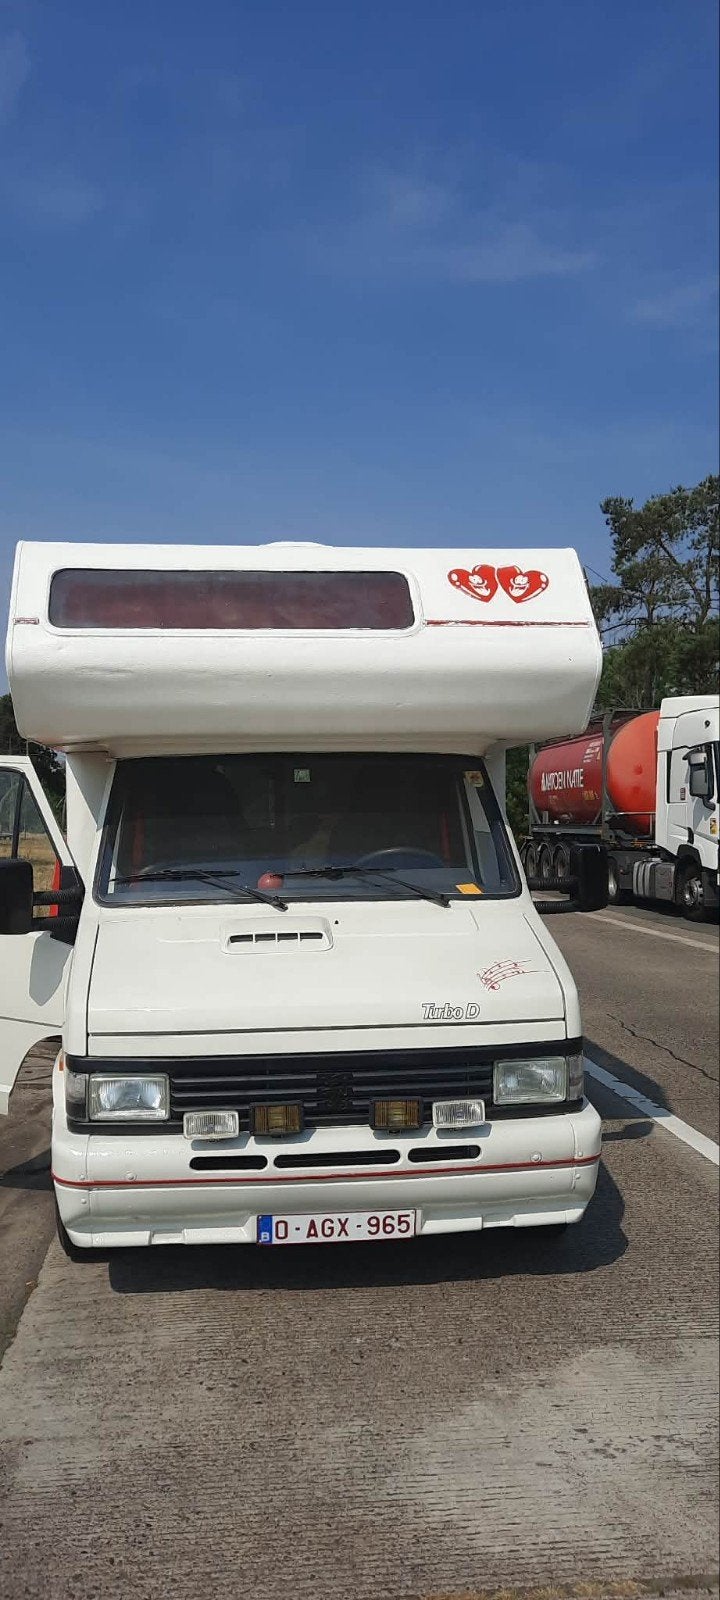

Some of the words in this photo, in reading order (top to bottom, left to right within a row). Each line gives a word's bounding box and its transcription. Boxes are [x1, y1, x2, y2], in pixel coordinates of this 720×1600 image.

[422, 1003, 464, 1019] Turbo
[465, 1003, 480, 1019] D
[261, 1231, 270, 1242] B
